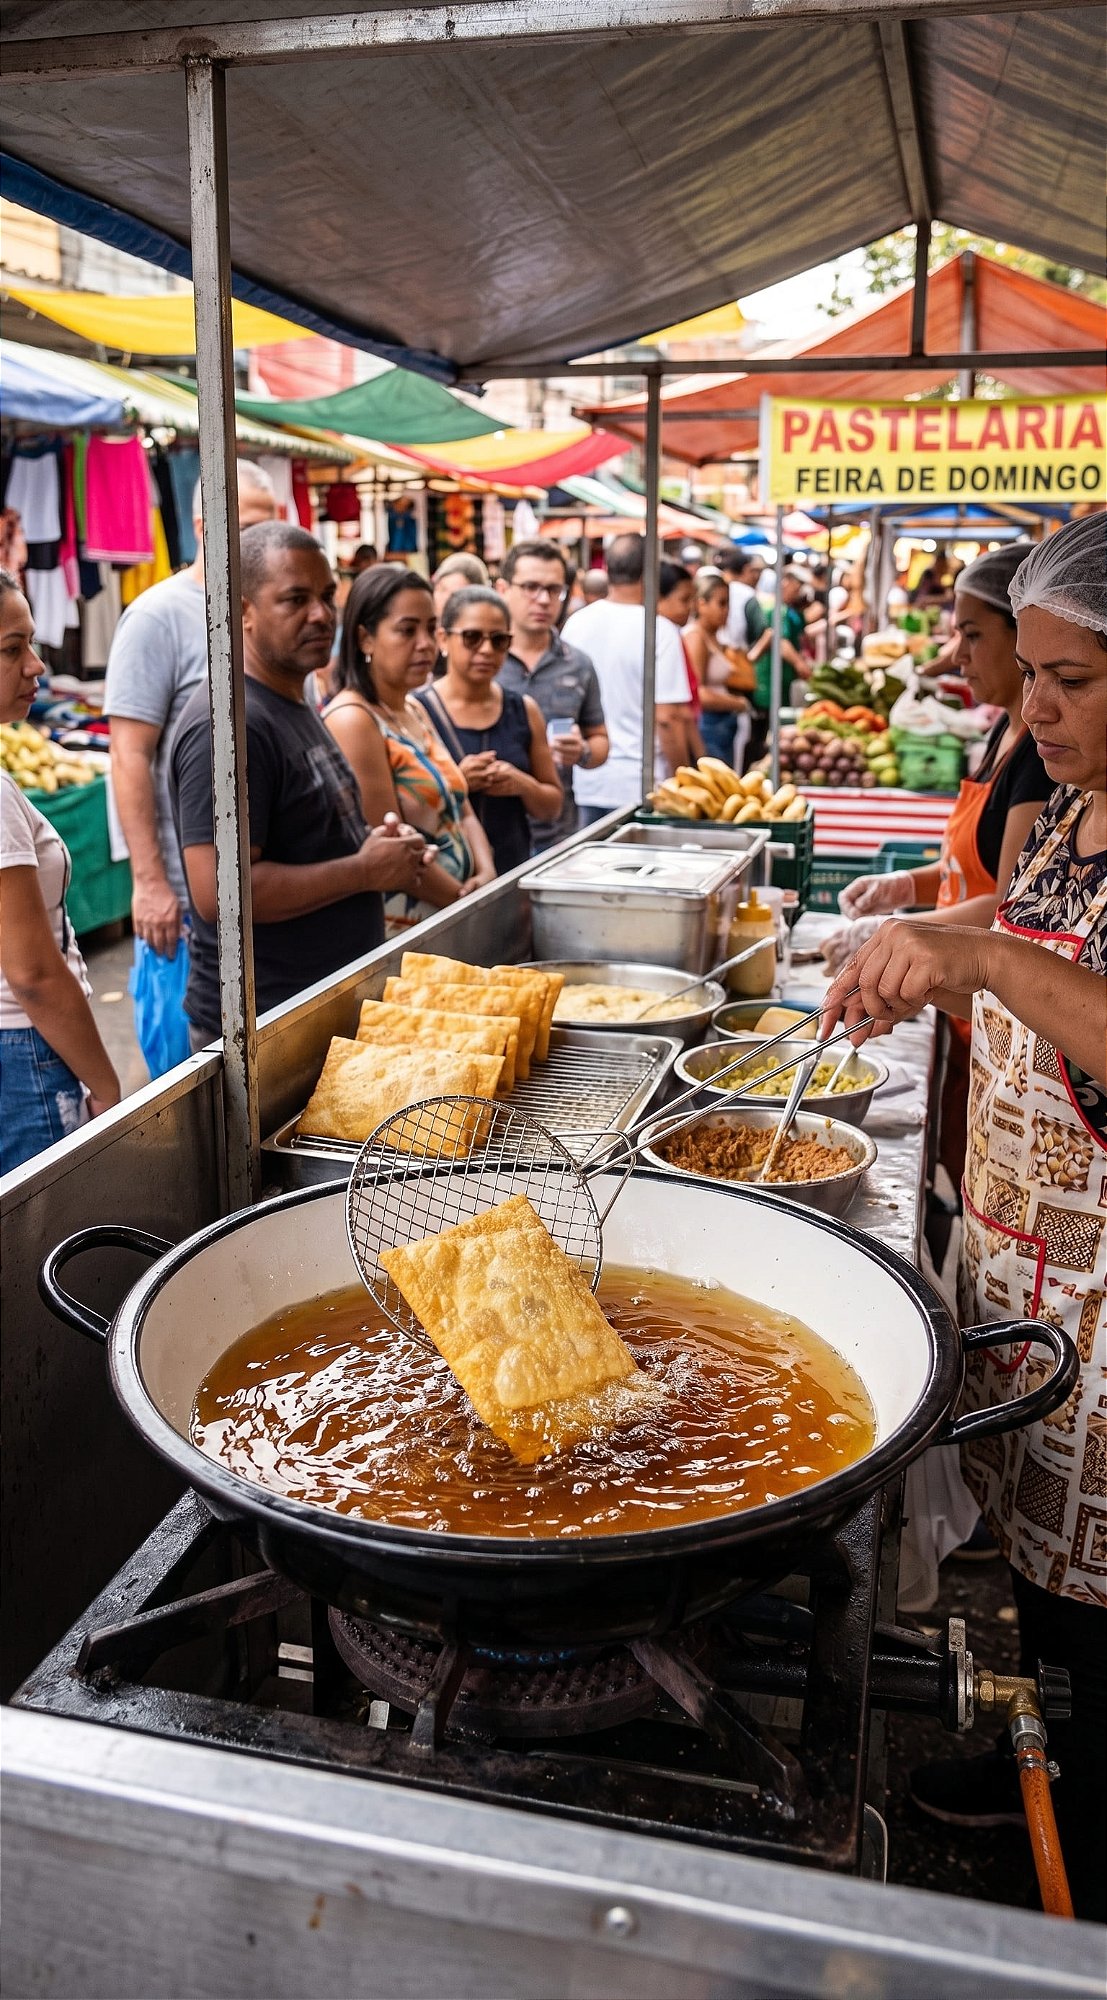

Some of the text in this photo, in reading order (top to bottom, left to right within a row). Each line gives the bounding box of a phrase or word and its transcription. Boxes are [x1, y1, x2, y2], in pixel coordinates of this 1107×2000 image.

[783, 403, 1104, 453] PASTELARIA
[797, 464, 1101, 493] FEIRA DE DOMINGO
